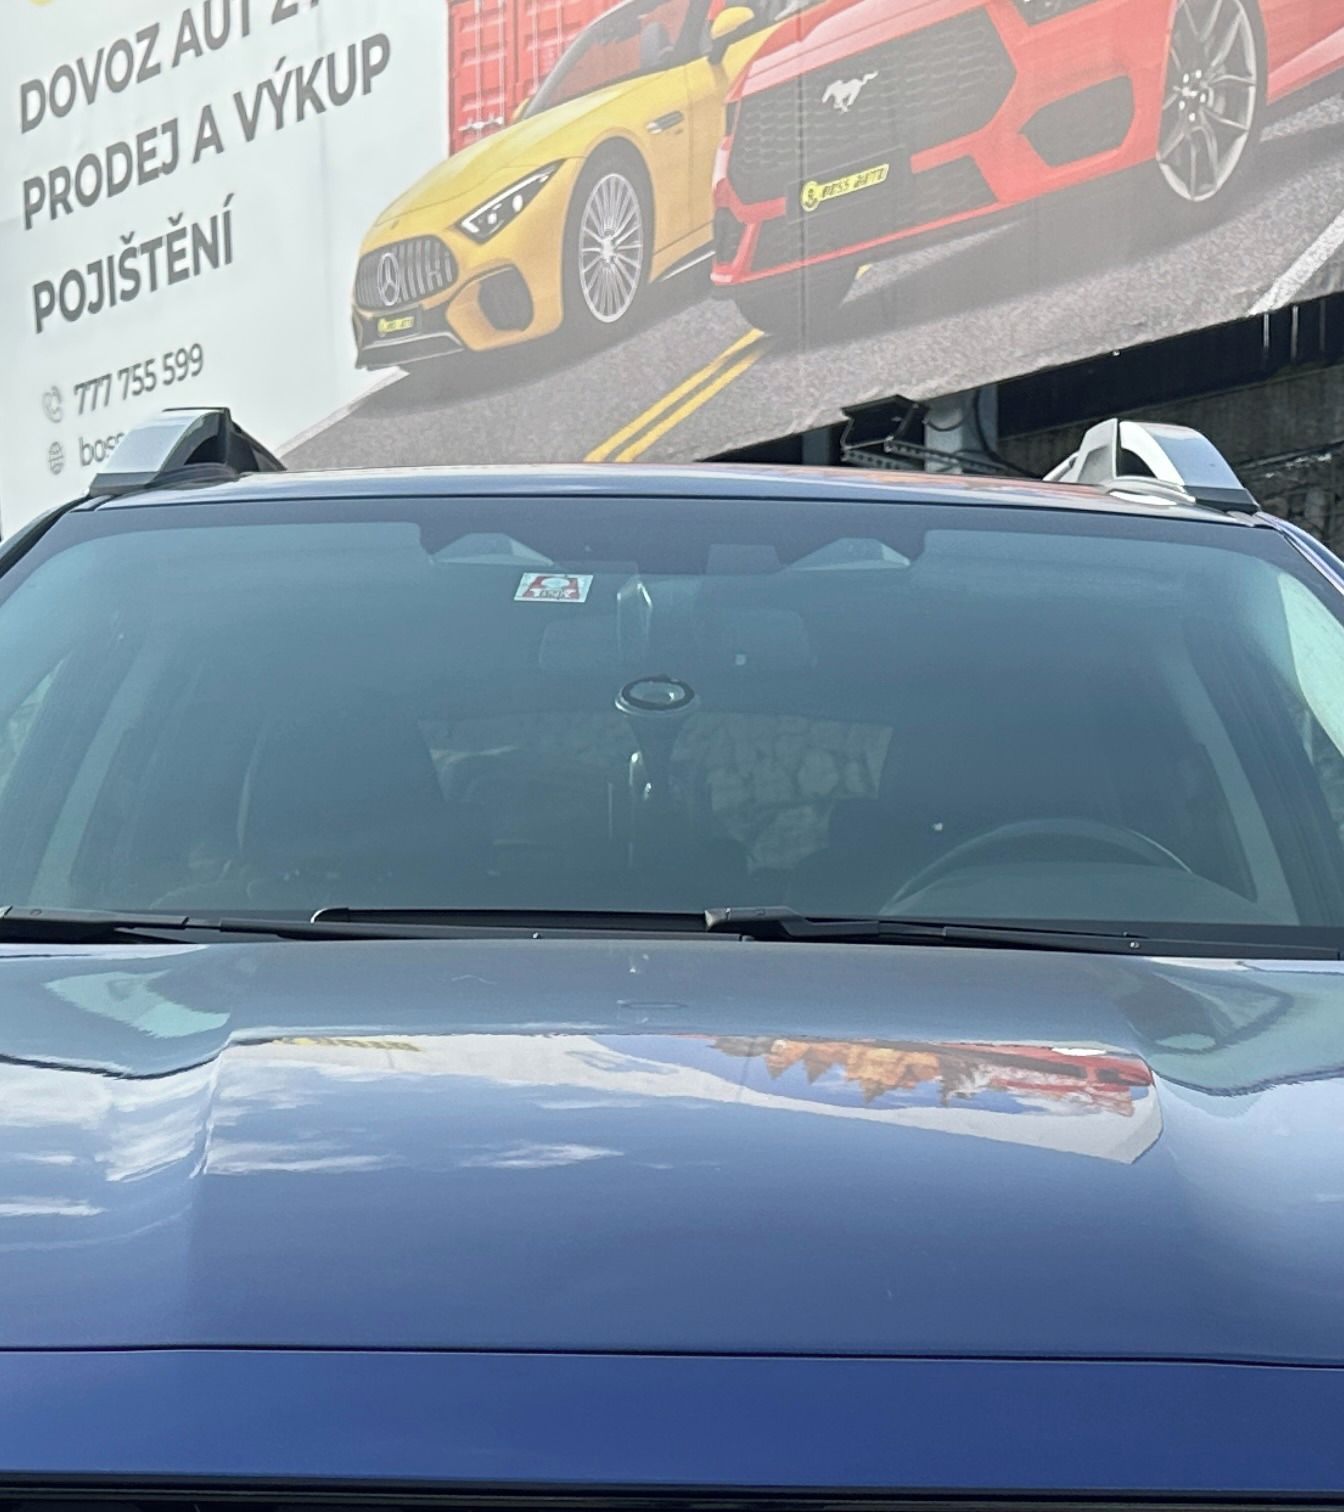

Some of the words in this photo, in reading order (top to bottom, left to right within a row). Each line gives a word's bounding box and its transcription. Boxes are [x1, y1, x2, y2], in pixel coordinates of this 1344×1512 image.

[20, 22, 161, 135] DOVOZ
[23, 117, 179, 230] PRODEJ
[192, 105, 224, 163] A
[234, 33, 392, 143] VÝKUP
[31, 193, 235, 334] POJIŠTĚNÍ
[74, 373, 112, 415] 777
[117, 358, 156, 400] 755
[162, 343, 203, 385] 599
